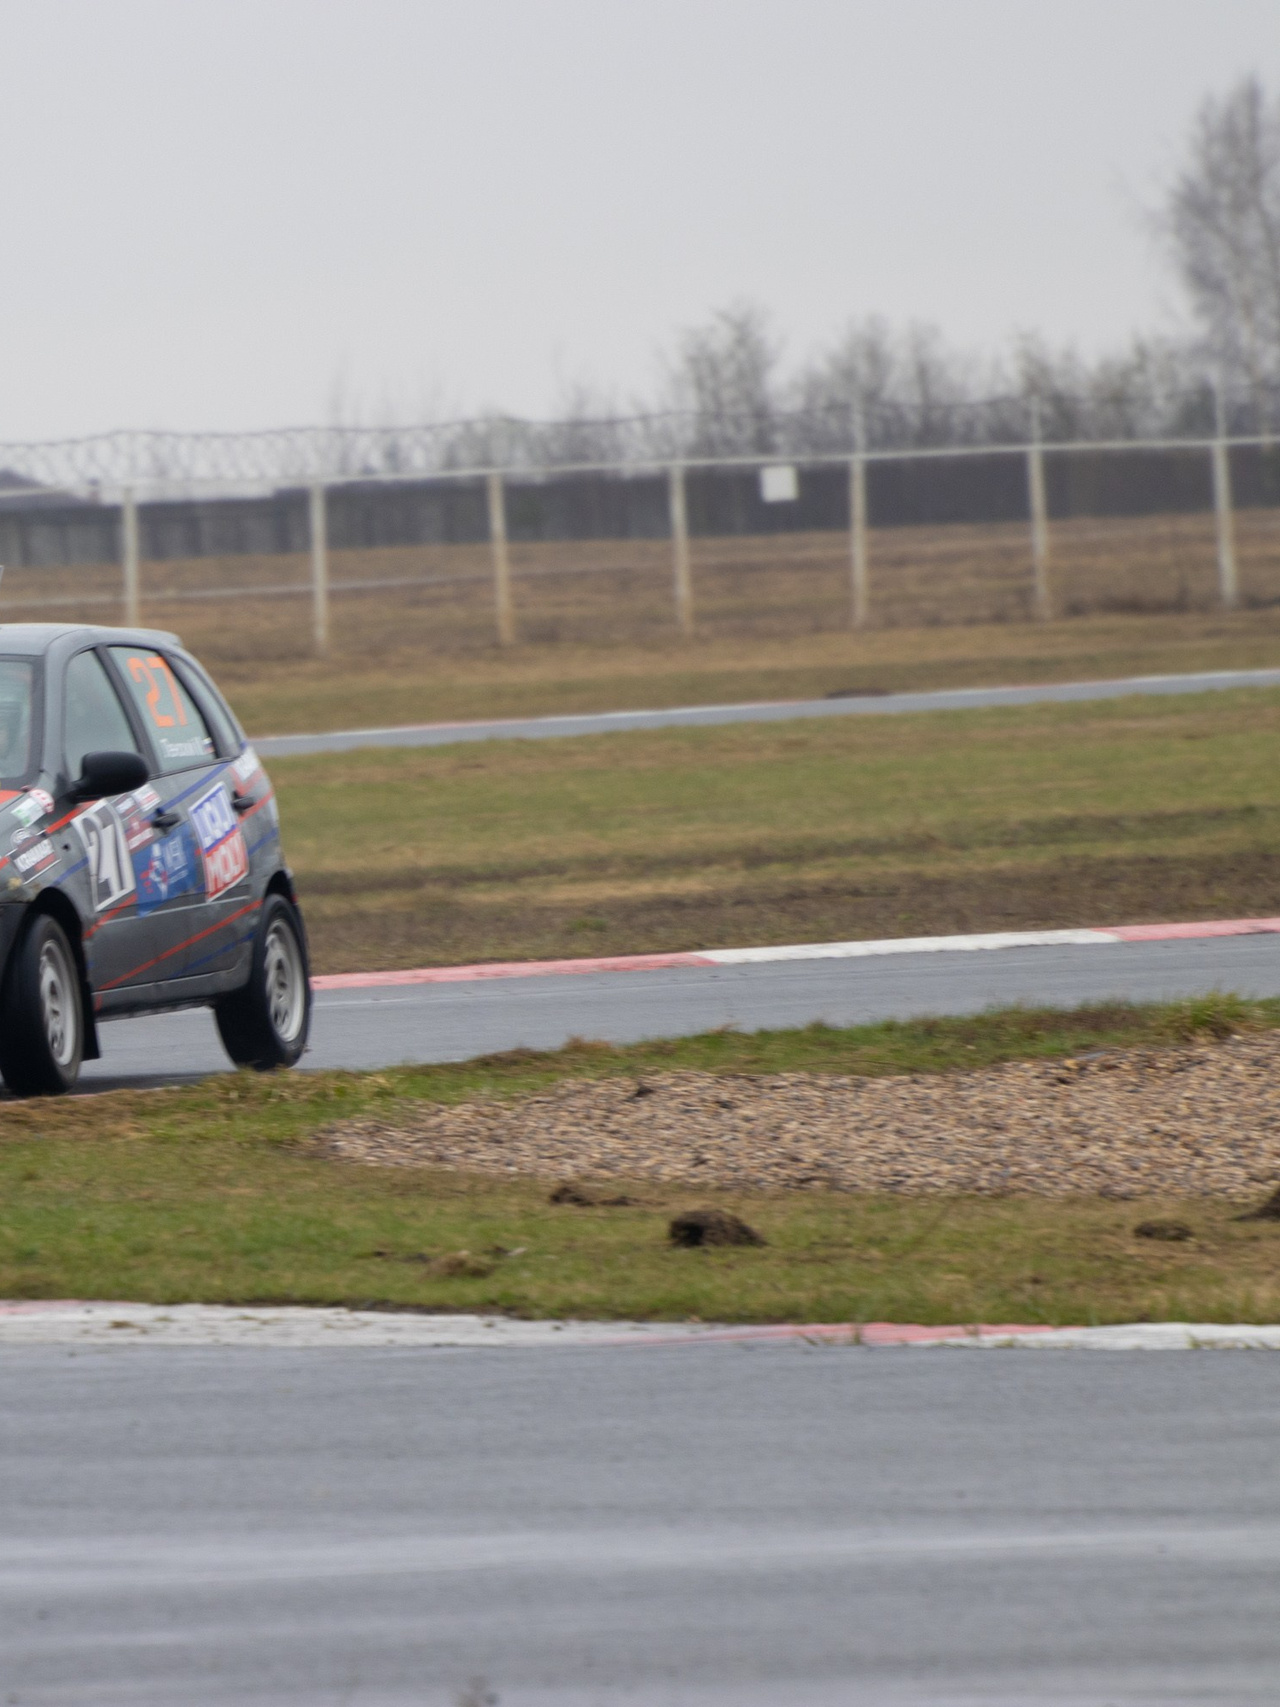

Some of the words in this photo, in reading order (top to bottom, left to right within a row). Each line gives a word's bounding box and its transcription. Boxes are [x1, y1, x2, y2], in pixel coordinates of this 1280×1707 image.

[126, 656, 188, 728] 27
[191, 788, 237, 851] LIQUI
[81, 805, 124, 907] 27
[205, 832, 249, 898] MOLY
